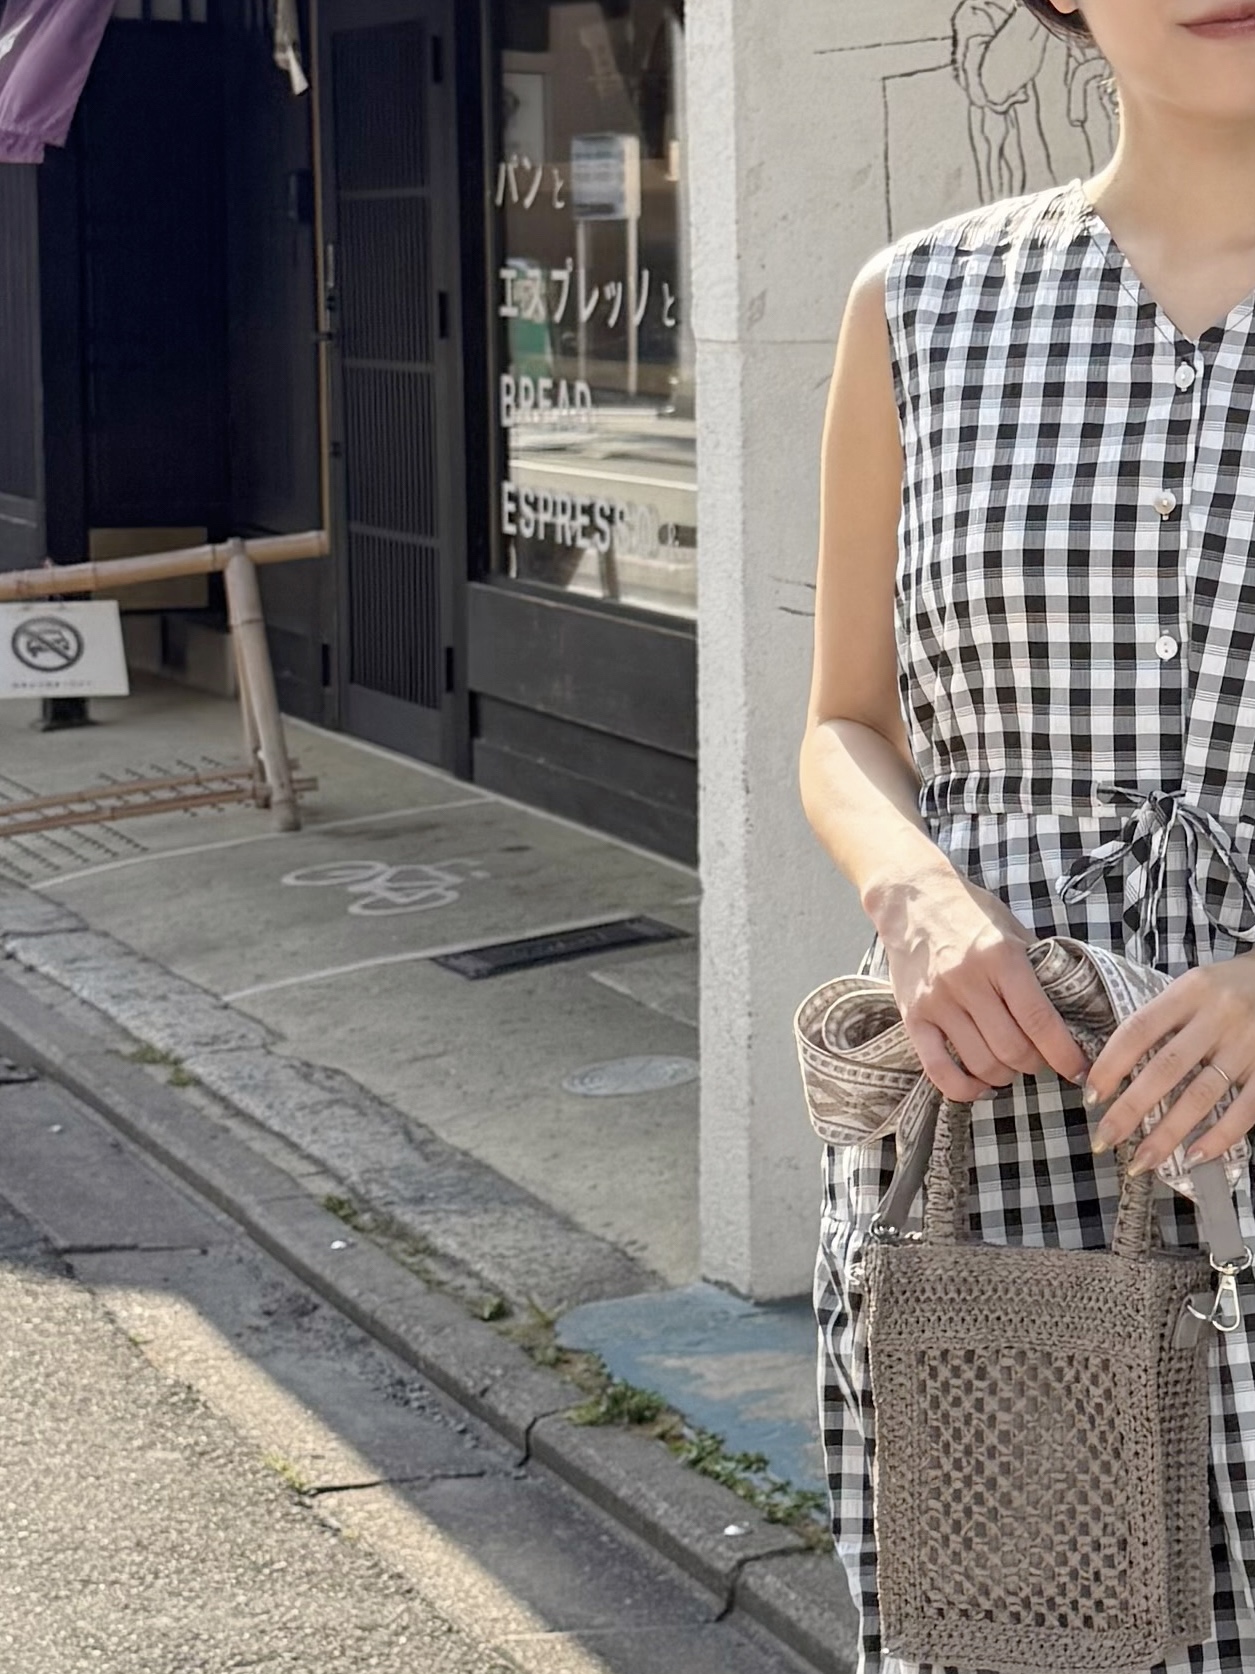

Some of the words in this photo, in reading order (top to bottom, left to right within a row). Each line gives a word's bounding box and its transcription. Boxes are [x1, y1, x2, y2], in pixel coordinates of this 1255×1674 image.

[495, 154, 565, 209] パンと
[501, 373, 592, 427] BREAD
[501, 481, 658, 558] ESPRESSO
